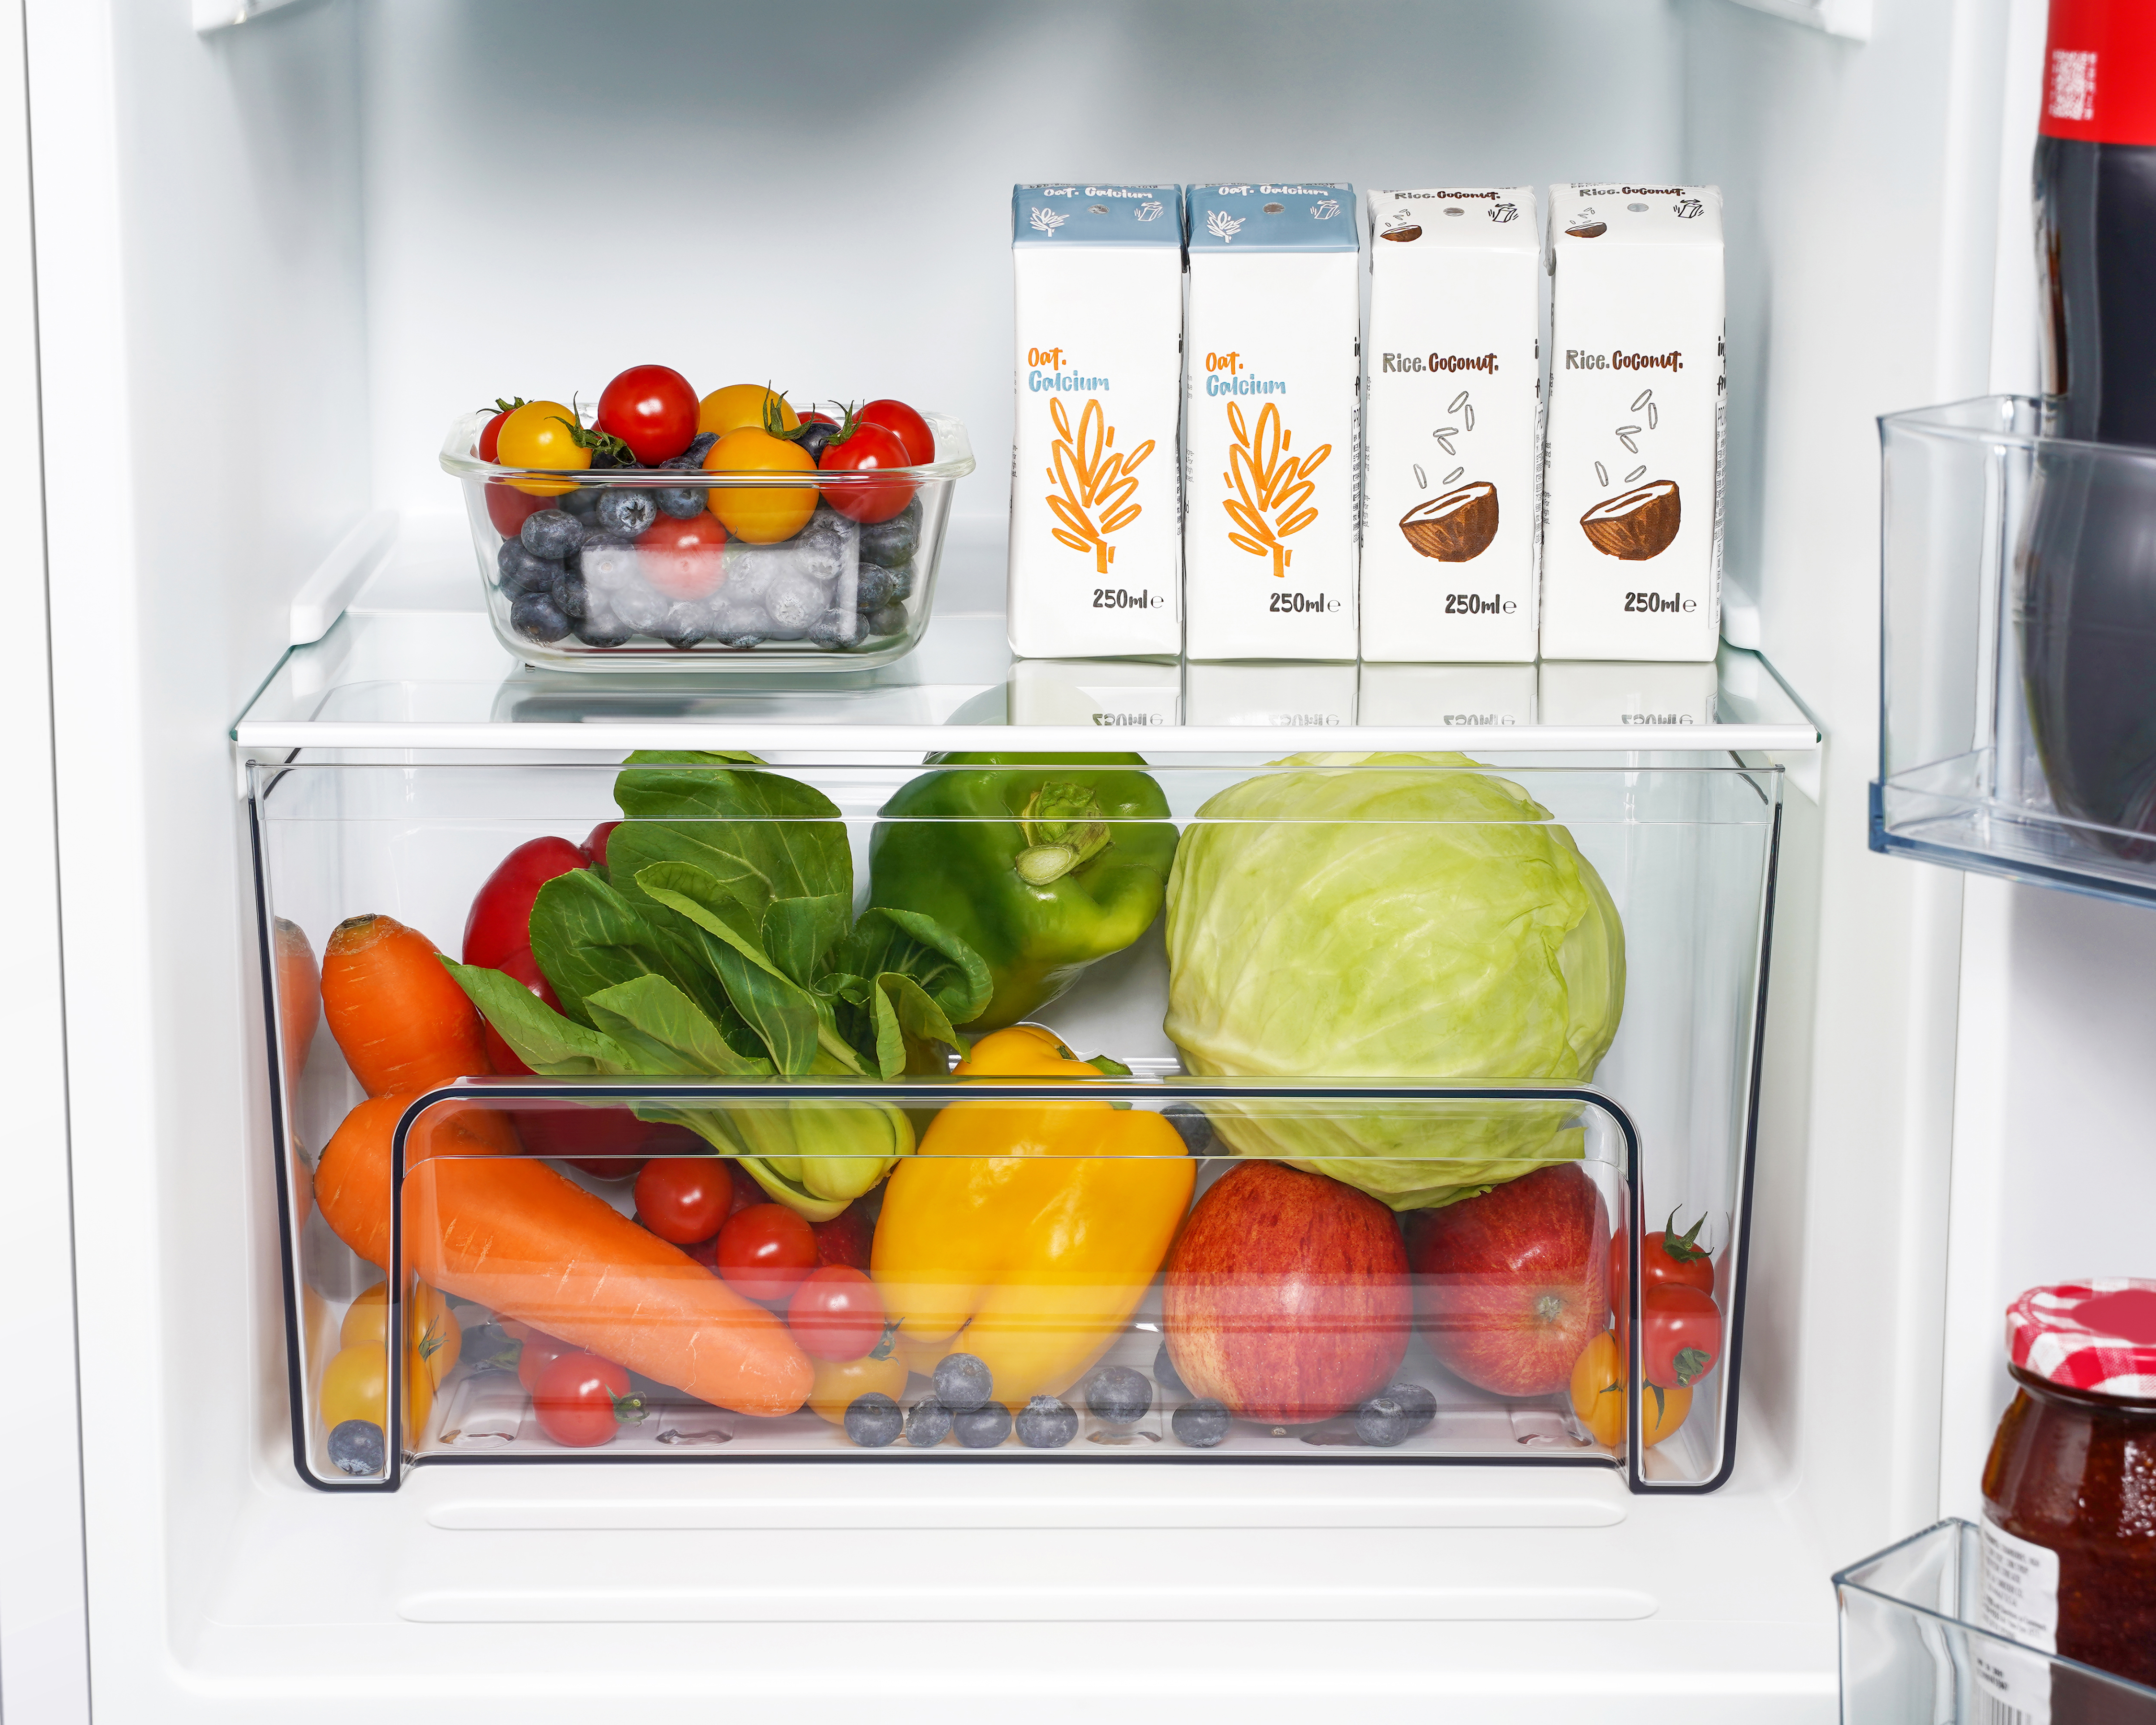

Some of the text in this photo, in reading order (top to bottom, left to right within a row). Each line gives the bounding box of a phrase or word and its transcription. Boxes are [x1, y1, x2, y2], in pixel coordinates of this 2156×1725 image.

[1044, 187, 1152, 198] Oat. Calcium
[1218, 185, 1254, 196] Oat.
[1260, 185, 1329, 196] Calcium
[1028, 347, 1067, 371] Oat.
[1205, 351, 1244, 375] Oat.
[1028, 370, 1110, 392] Calcium
[1206, 374, 1286, 397] Calcium
[1092, 588, 1147, 609] 250ml
[1269, 592, 1324, 613] 250ml
[1445, 593, 1501, 615] 250ml
[1624, 592, 1680, 613] 250ml
